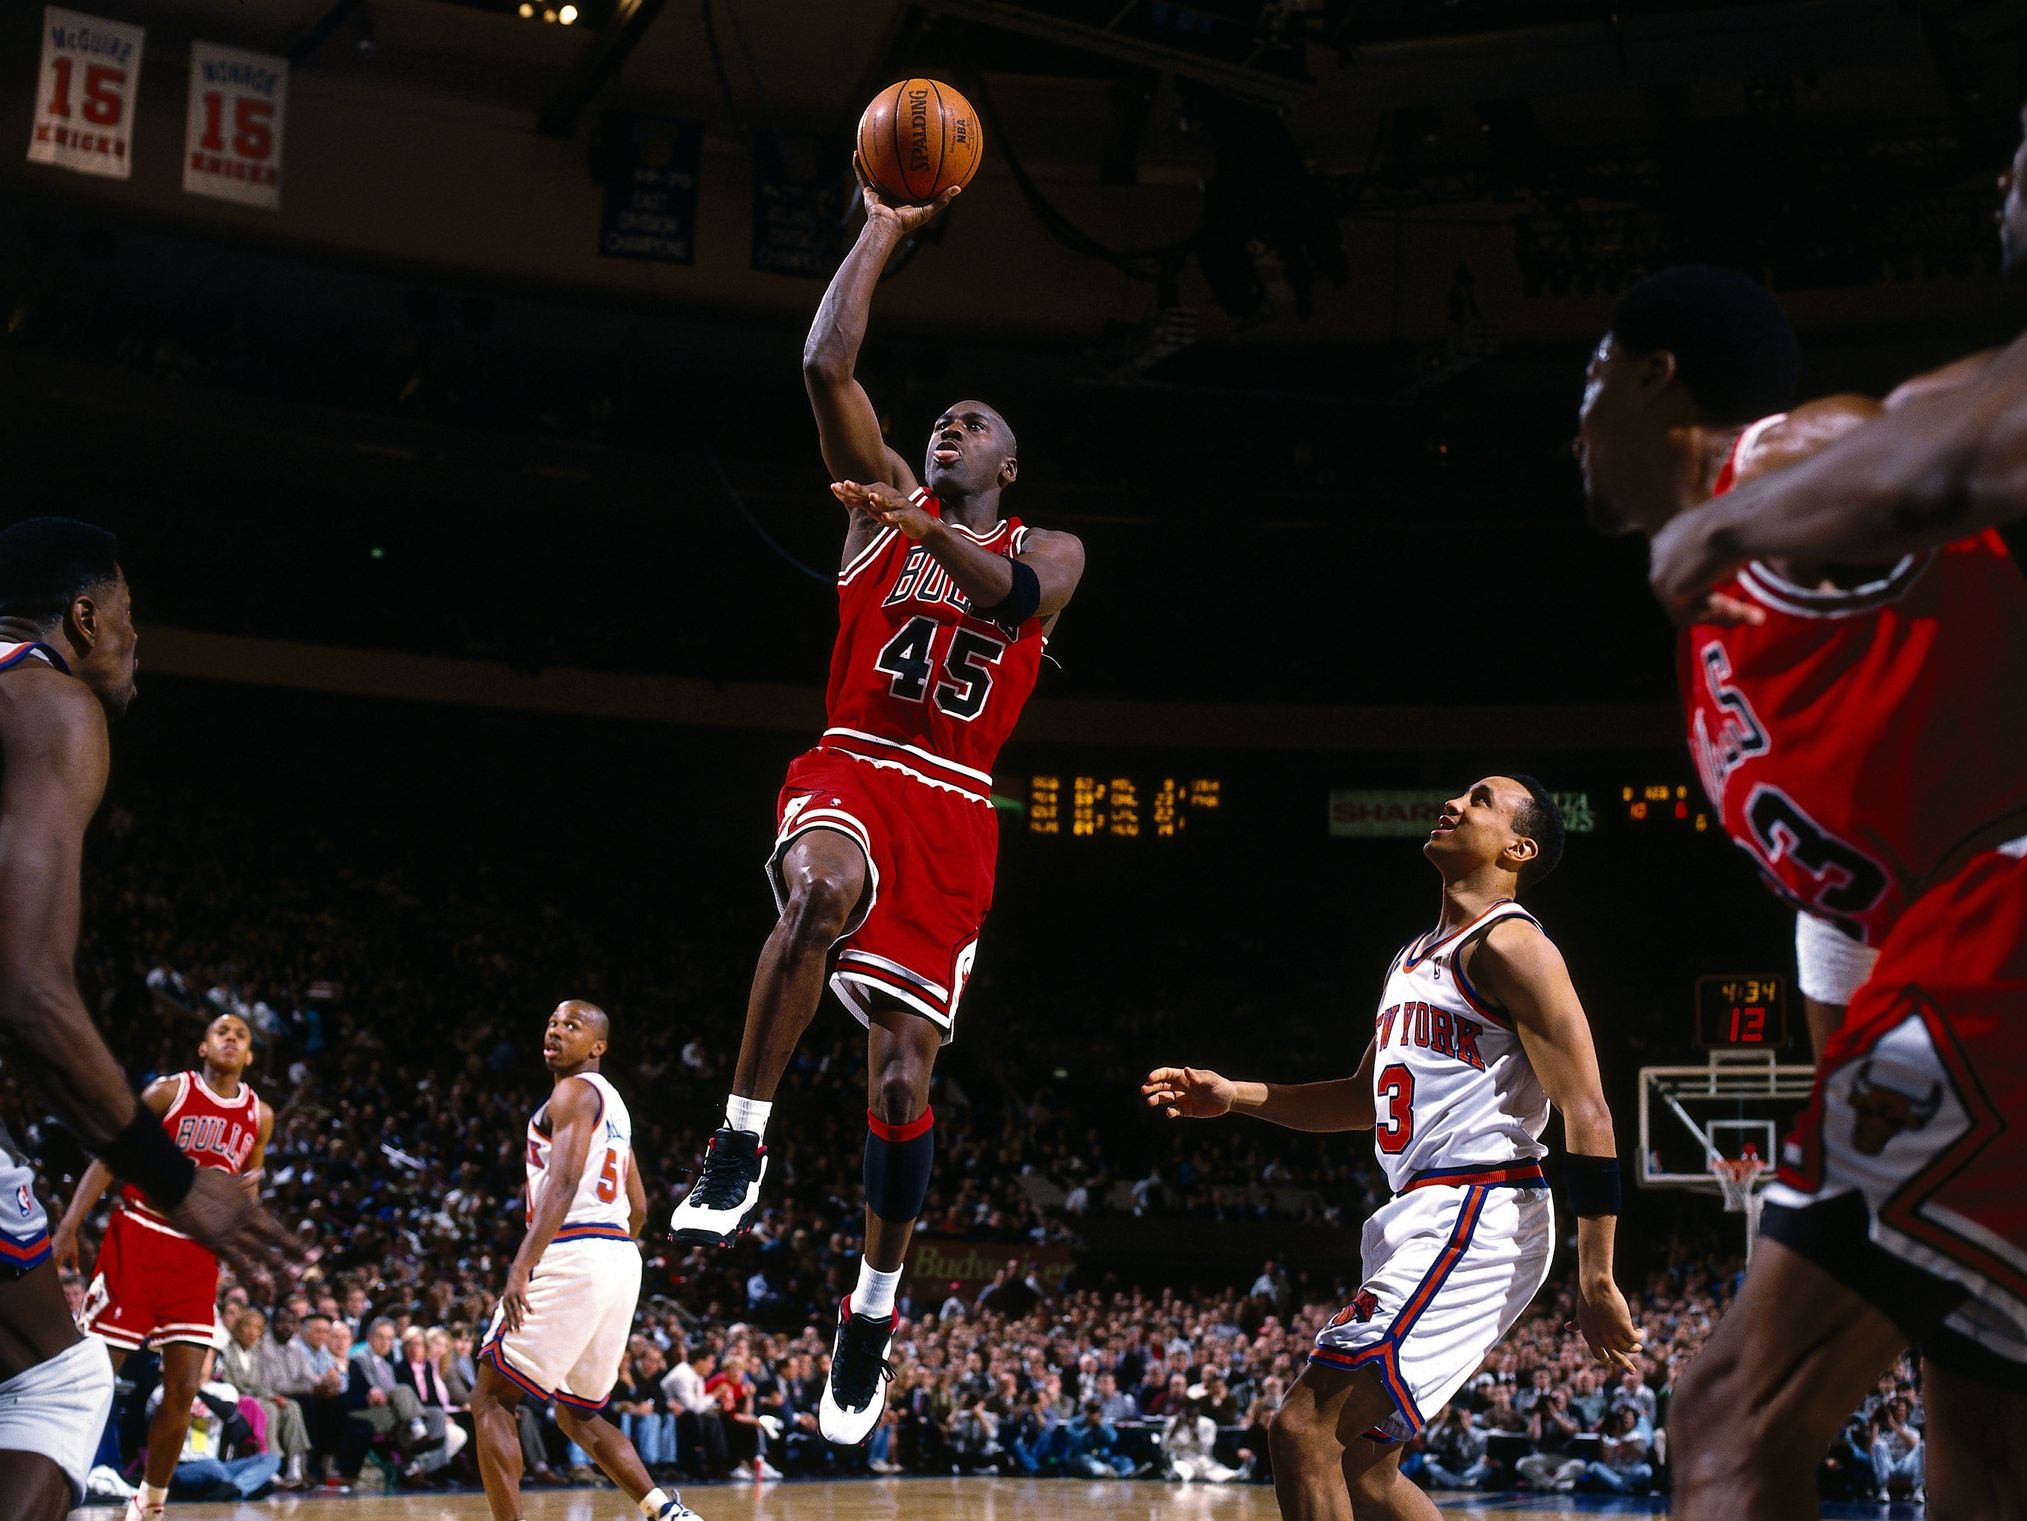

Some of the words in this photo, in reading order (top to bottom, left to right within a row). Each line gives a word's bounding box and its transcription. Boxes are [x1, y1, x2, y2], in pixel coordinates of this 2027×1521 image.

[49, 56, 127, 126] 15
[202, 90, 274, 161] 15
[908, 88, 930, 172] SPALDING
[956, 119, 967, 144] NBA
[873, 614, 1007, 722] 45
[1400, 1001, 1486, 1073] YORK
[1376, 1062, 1416, 1155] 3
